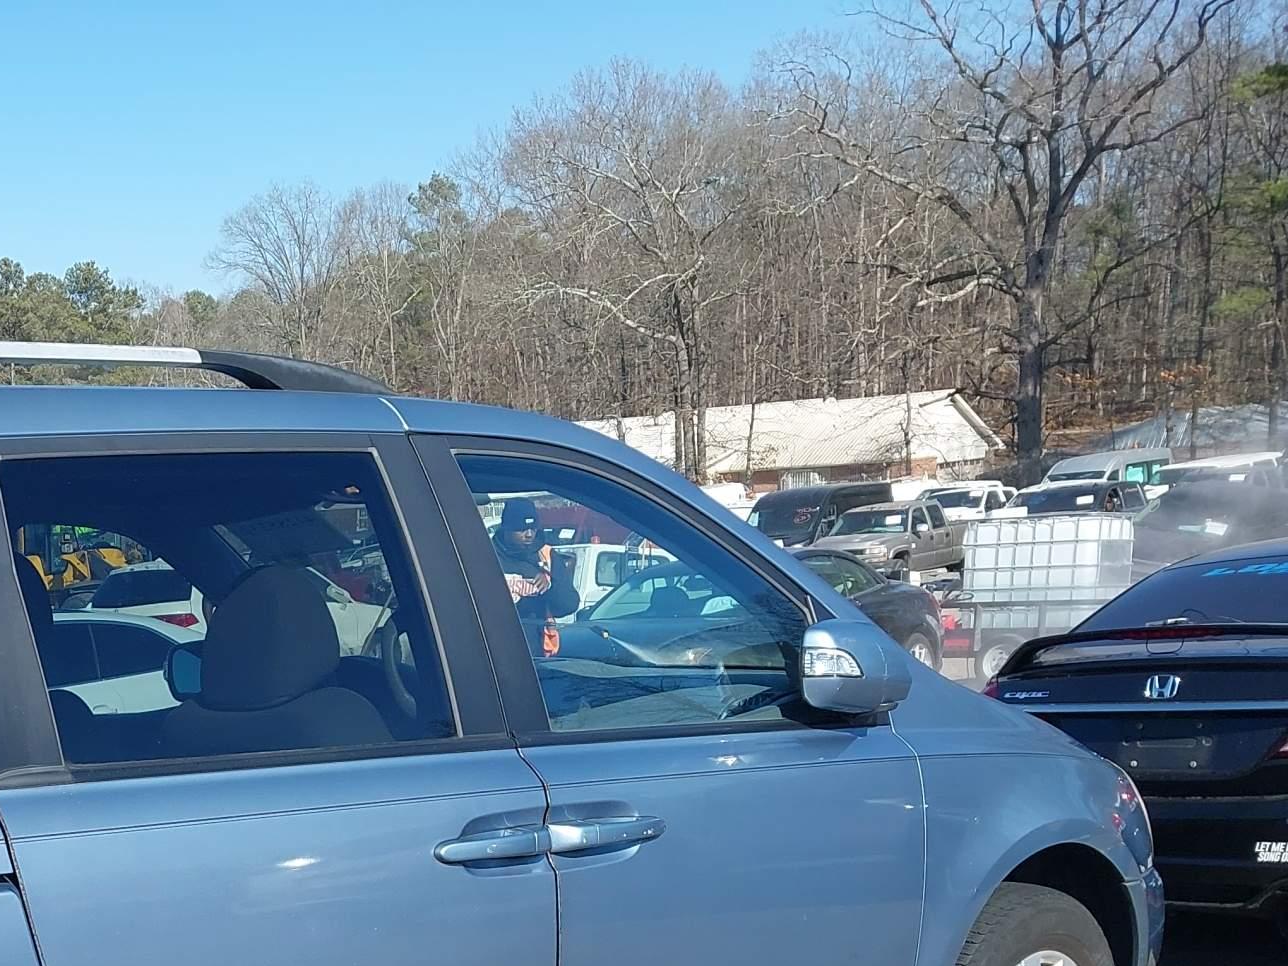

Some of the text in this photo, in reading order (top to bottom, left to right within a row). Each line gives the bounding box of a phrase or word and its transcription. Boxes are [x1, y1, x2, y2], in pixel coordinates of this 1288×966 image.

[1255, 842, 1271, 852] LET
[1271, 842, 1286, 852] ME
[1258, 852, 1280, 862] SONG
